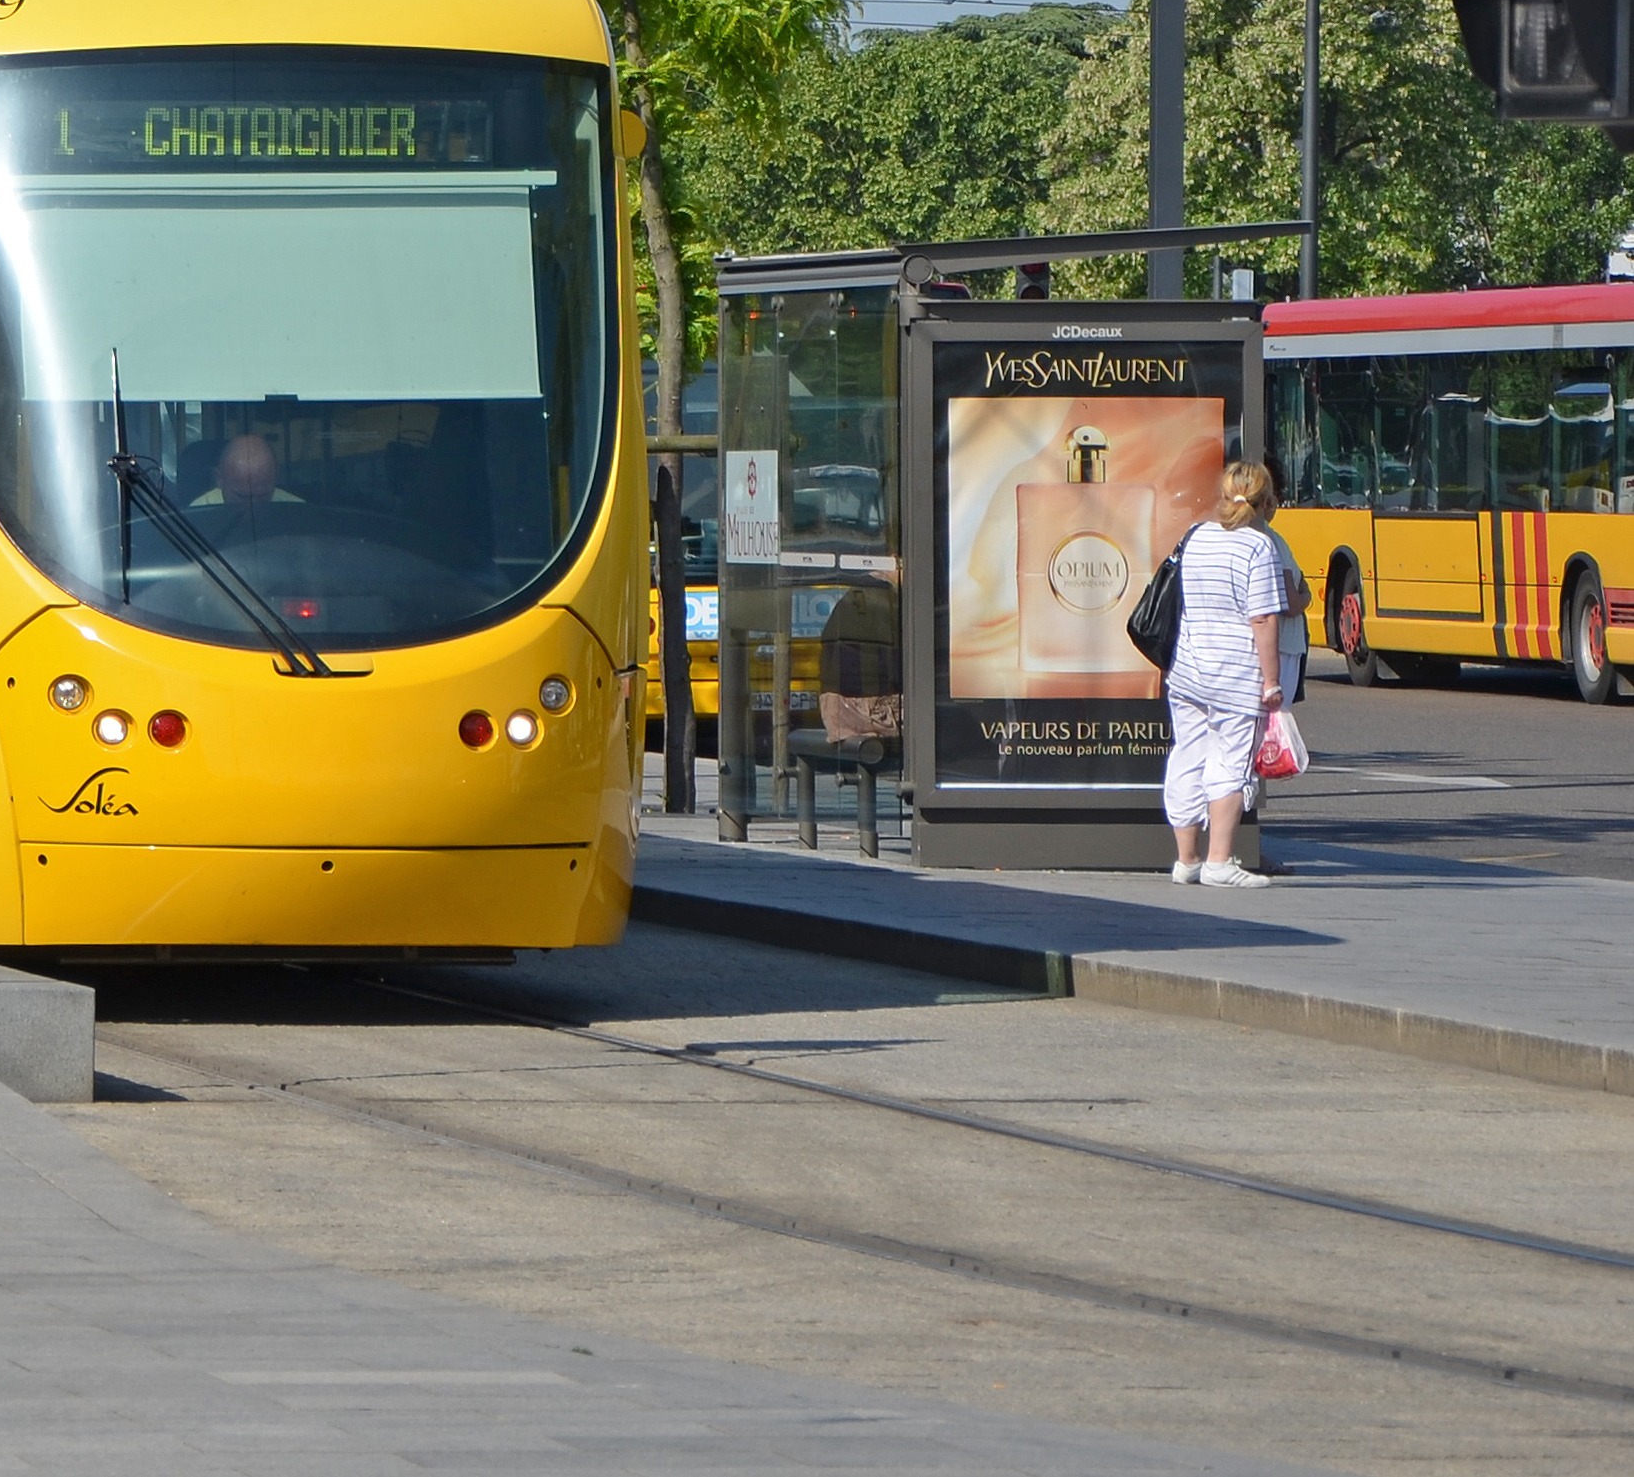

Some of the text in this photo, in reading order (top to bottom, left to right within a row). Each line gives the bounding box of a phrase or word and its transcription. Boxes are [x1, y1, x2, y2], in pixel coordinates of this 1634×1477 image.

[54, 107, 416, 156] 1 CHATAIGNIER
[1052, 325, 1123, 339] JCDecaux
[1057, 561, 1120, 578] OPIUM
[981, 722, 1172, 740] VAPEURS DE PARFU
[998, 743, 1013, 755] Le
[1017, 745, 1073, 756] nouveau
[1077, 742, 1124, 758] parfum
[37, 766, 140, 816] Soléa
